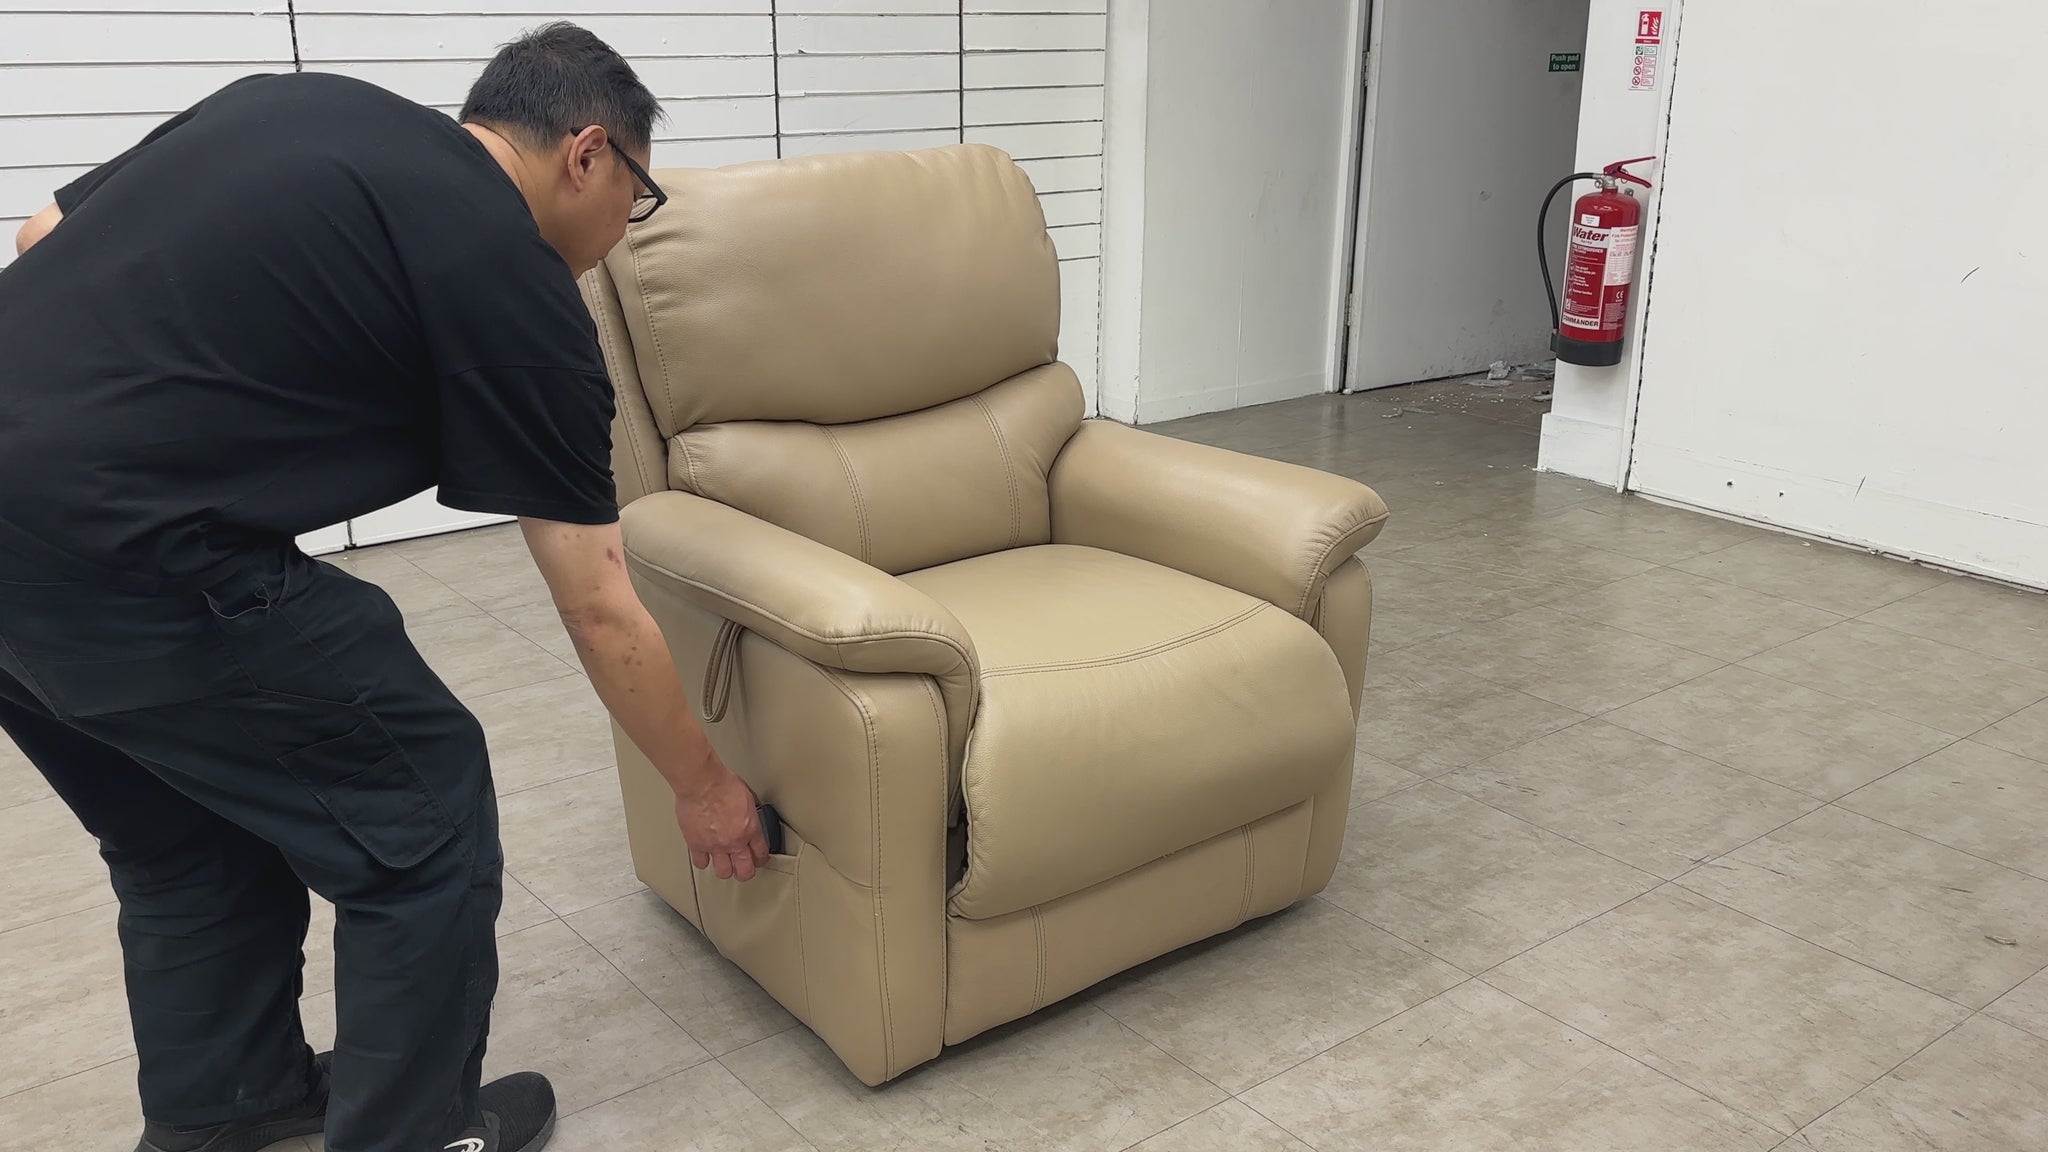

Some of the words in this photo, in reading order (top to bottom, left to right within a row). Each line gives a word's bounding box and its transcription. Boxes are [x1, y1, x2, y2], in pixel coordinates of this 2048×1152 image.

[1567, 54, 1579, 62] pad
[1572, 226, 1609, 242] Water
[1563, 314, 1599, 327] COMMANDER
